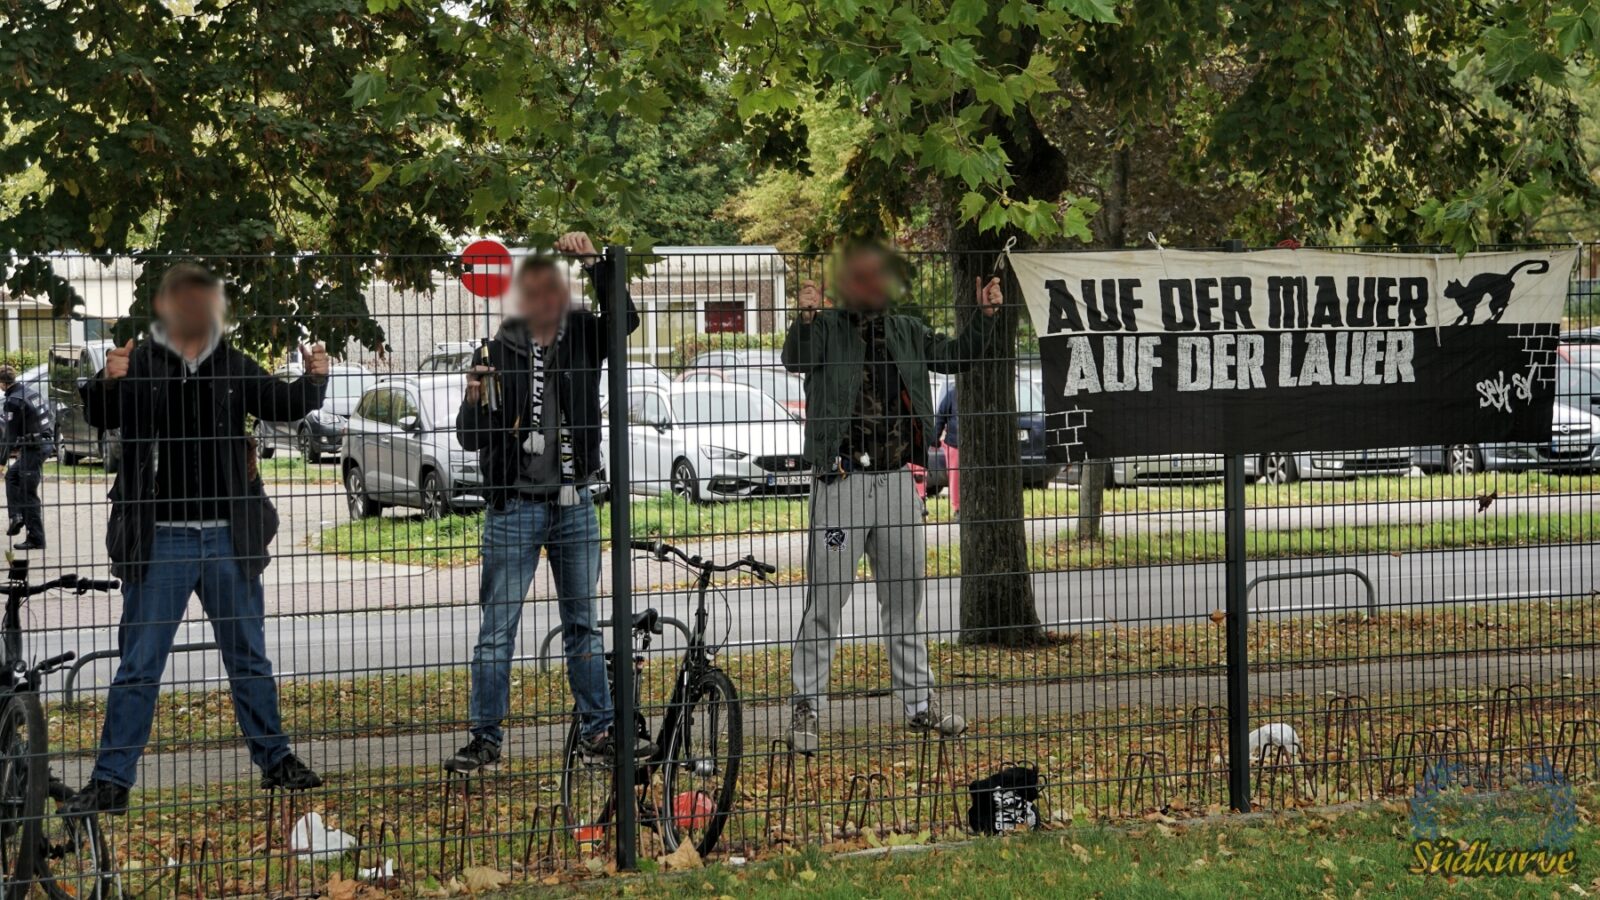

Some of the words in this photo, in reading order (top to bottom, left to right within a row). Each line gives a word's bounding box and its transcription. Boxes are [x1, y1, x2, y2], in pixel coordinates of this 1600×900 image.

[1045, 279, 1143, 334] AUF
[1159, 277, 1256, 331] DER
[1268, 276, 1429, 329] MAUER
[1064, 336, 1163, 396] AUF
[1177, 334, 1267, 391] DER
[1279, 331, 1416, 387] LAUER
